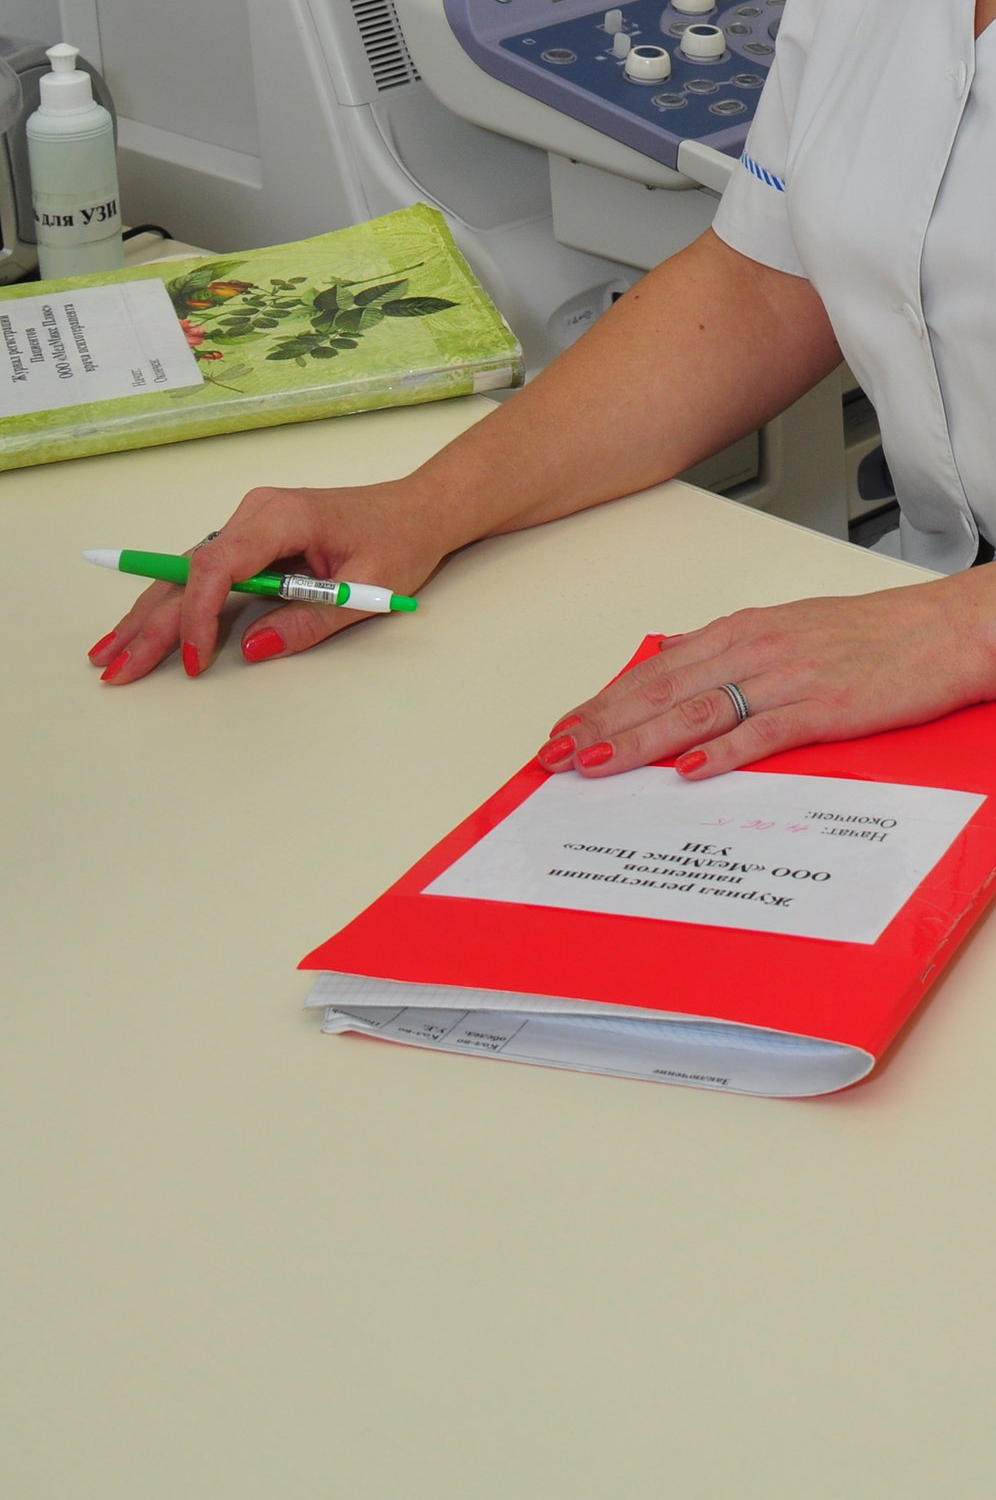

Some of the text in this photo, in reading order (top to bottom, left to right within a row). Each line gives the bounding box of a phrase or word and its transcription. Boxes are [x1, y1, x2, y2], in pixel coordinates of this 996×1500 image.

[42, 213, 74, 227] для
[80, 199, 117, 225] УЗИ
[55, 362, 74, 380] ООО
[805, 810, 898, 829] Окончен:
[821, 827, 889, 842] Начат:
[680, 842, 733, 856] УЗИ
[563, 842, 832, 882] ООО «МедМикс Плюс»
[623, 863, 745, 884] пациентов
[546, 868, 795, 907] Журнал регистрации
[457, 1038, 499, 1051] Кол-во
